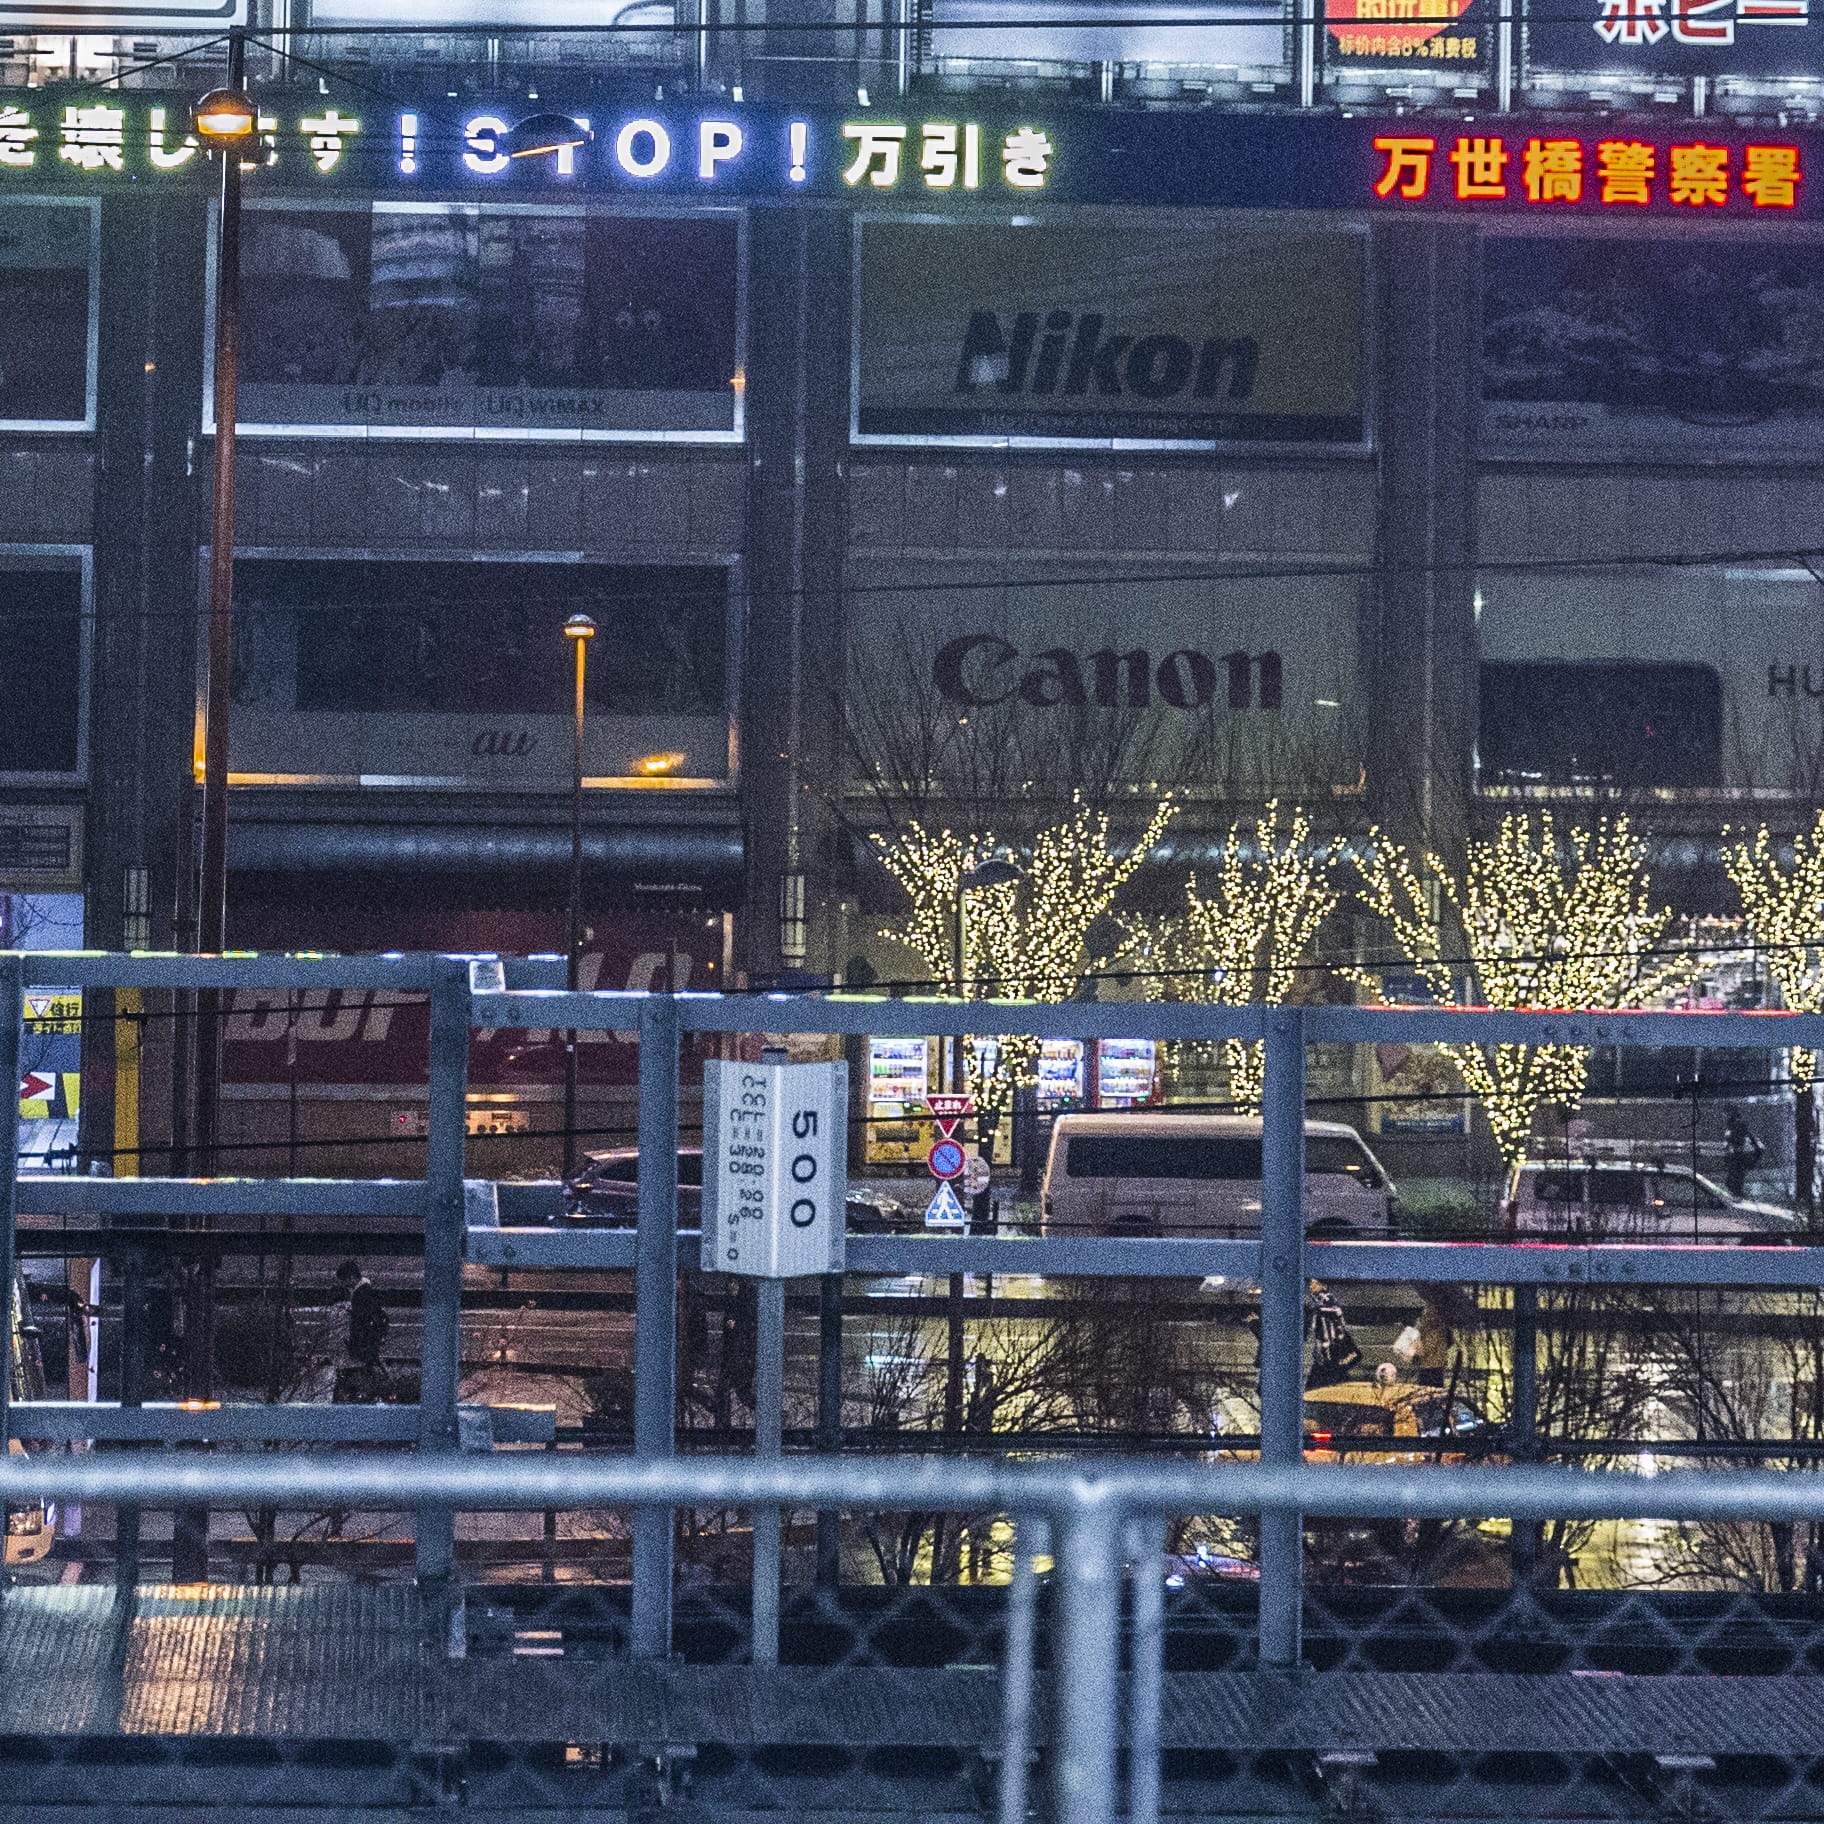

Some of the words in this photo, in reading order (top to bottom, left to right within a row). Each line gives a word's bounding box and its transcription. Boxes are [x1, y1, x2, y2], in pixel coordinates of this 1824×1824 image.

[842, 122, 1052, 189] 万引き
[1374, 137, 1802, 208] 万世橋警察署
[954, 310, 1261, 400] Nikon
[932, 633, 1283, 710] Canon
[473, 728, 536, 758] au
[789, 1109, 819, 1229] 500
